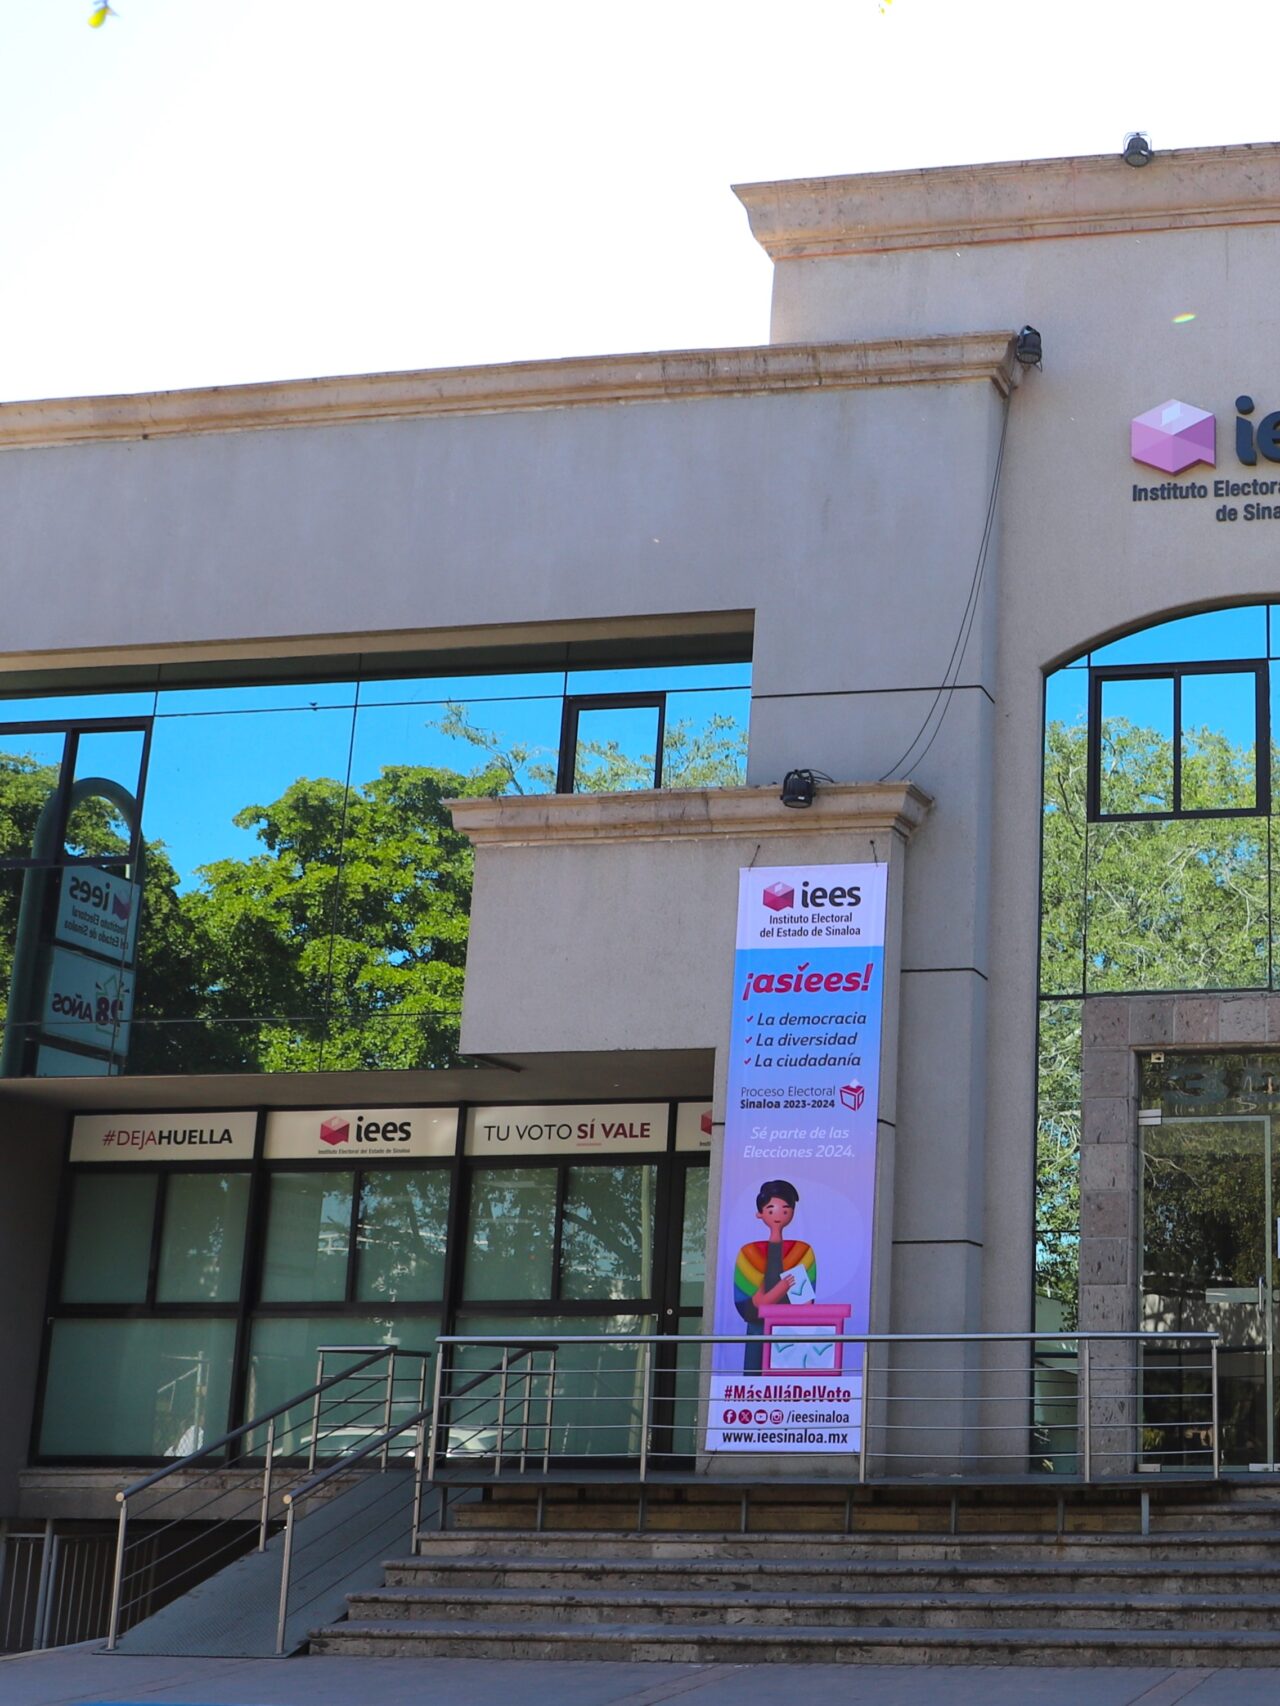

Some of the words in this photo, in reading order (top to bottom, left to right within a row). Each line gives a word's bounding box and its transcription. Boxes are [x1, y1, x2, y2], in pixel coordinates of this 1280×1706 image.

[1132, 483, 1208, 502] Instituto
[1216, 504, 1238, 522] de
[802, 881, 861, 909] iees
[769, 913, 809, 925] Instituto
[811, 912, 853, 924] Electoral
[760, 926, 774, 938] del
[776, 926, 809, 938] Estado
[811, 925, 823, 937] de
[825, 925, 861, 937] Sinaloa
[757, 1012, 774, 1026] La
[779, 1011, 867, 1026] democracia
[756, 1033, 773, 1047] La
[777, 1032, 858, 1047] diversidad
[754, 1054, 772, 1068] La
[776, 1053, 861, 1068] ciudadanía
[740, 1086, 785, 1098] Proceso
[787, 1085, 836, 1097] Electoral
[740, 1099, 781, 1110] Sinaloa
[783, 1098, 835, 1109] 2023-2024
[355, 1115, 412, 1142] iees
[484, 1125, 510, 1142] TU
[515, 1123, 572, 1141] VOTO
[577, 1118, 595, 1140] SÍ
[601, 1122, 651, 1139] VALE
[750, 1126, 768, 1140] Sé
[770, 1128, 806, 1143] parte
[809, 1126, 826, 1140] de
[829, 1126, 849, 1140] las
[102, 1128, 233, 1150] #DEJAHUELLA
[743, 1145, 813, 1159] Elecciones
[816, 1145, 855, 1159] 2024.
[724, 1385, 851, 1402] #MásAlláDelVoto
[786, 1410, 850, 1424] /ieesinaloa
[722, 1428, 848, 1444] www.ieesinaloa.mx
